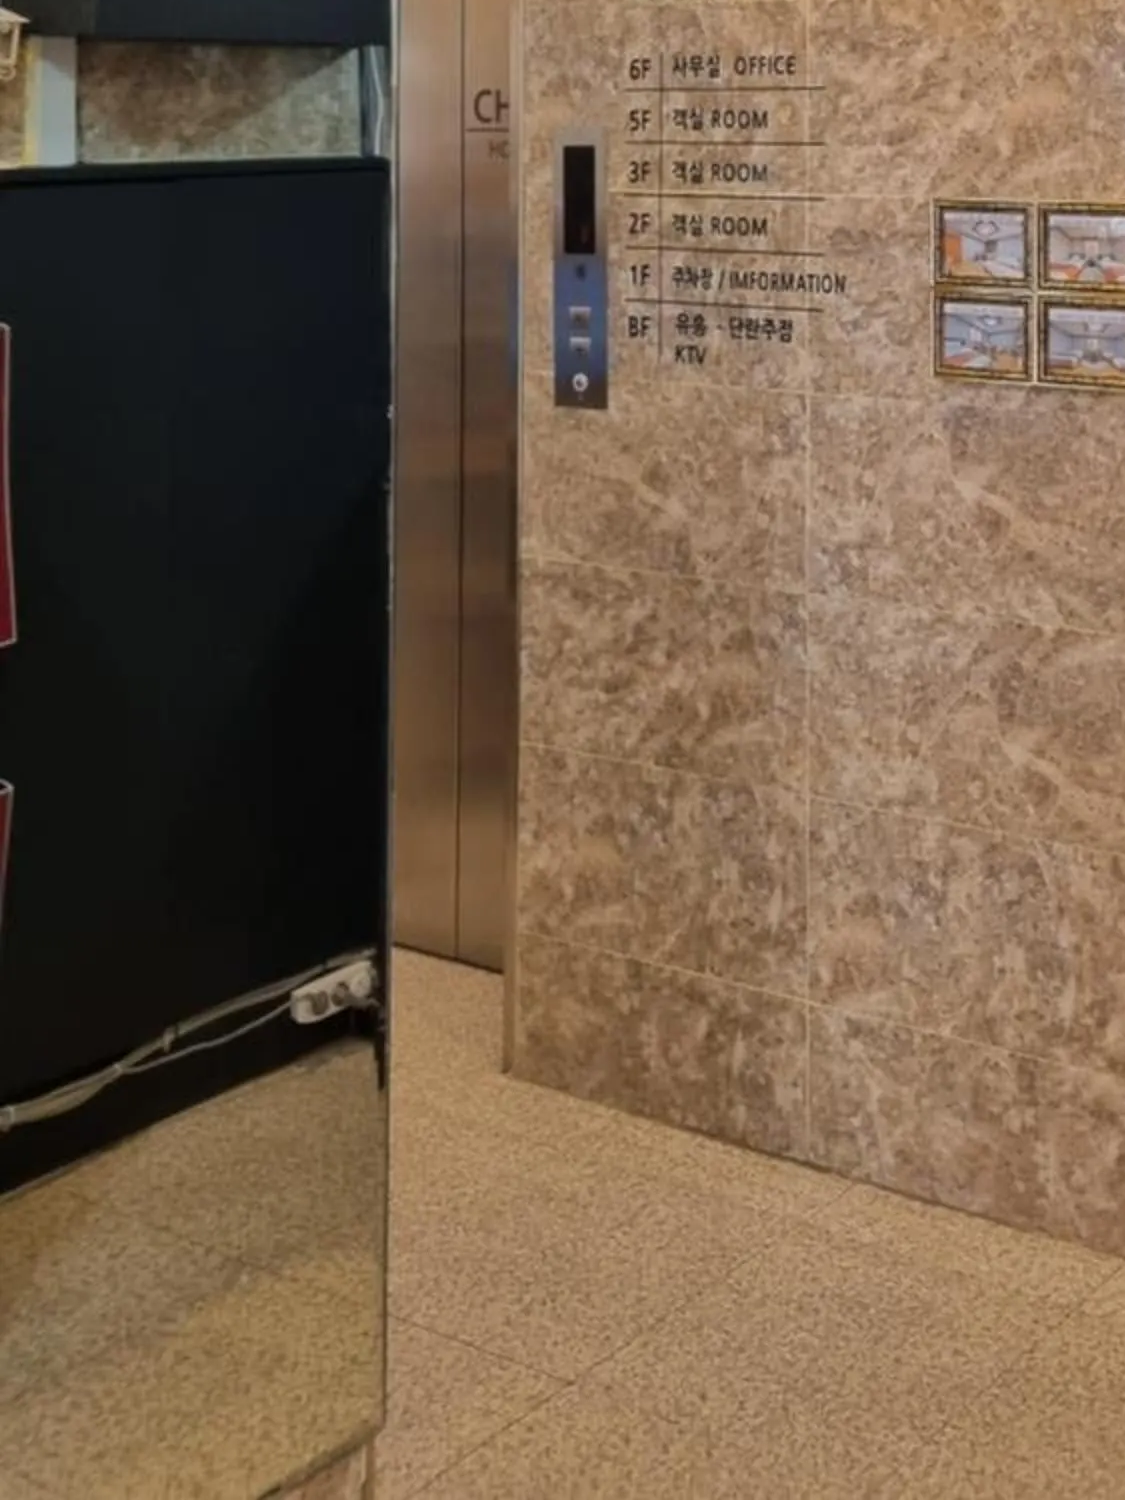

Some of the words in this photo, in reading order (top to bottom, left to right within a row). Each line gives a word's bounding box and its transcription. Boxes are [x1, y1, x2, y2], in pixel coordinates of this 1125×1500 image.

[628, 58, 652, 81] 6F
[672, 55, 721, 78] 사무실
[734, 55, 797, 76] OFFICE
[629, 109, 652, 132] 5F
[672, 107, 704, 131] 객실
[710, 108, 769, 130] ROOM
[628, 161, 651, 184] 3F
[672, 161, 704, 184] 객실
[710, 162, 768, 183] ROOM
[628, 212, 651, 235] 2F
[672, 213, 704, 236] 객실
[710, 215, 768, 237] ROOM
[629, 264, 651, 286] 1F
[729, 271, 847, 294] IMFORMATION
[628, 315, 651, 338] BF
[674, 345, 707, 365] KTV
